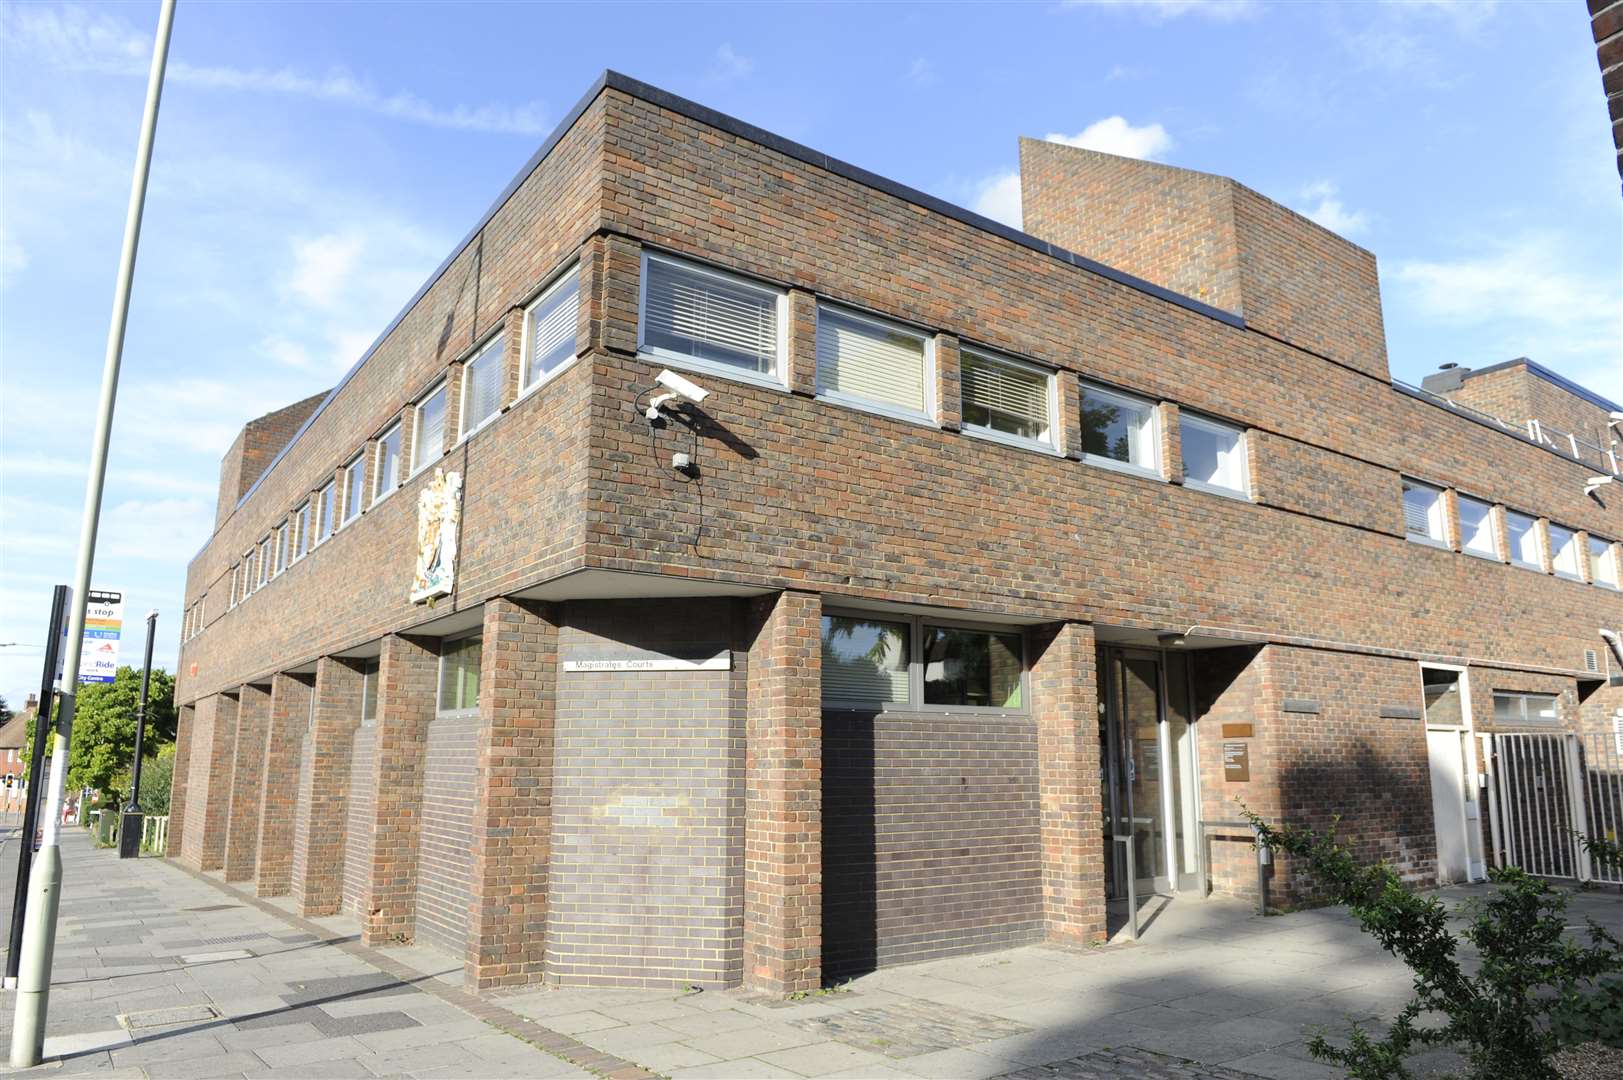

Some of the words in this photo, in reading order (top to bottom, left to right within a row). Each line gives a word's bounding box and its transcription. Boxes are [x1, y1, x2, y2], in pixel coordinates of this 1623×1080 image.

[94, 609, 114, 618] stop
[96, 660, 115, 669] Ride
[575, 661, 621, 669] Magistrates
[626, 660, 653, 668] Courts
